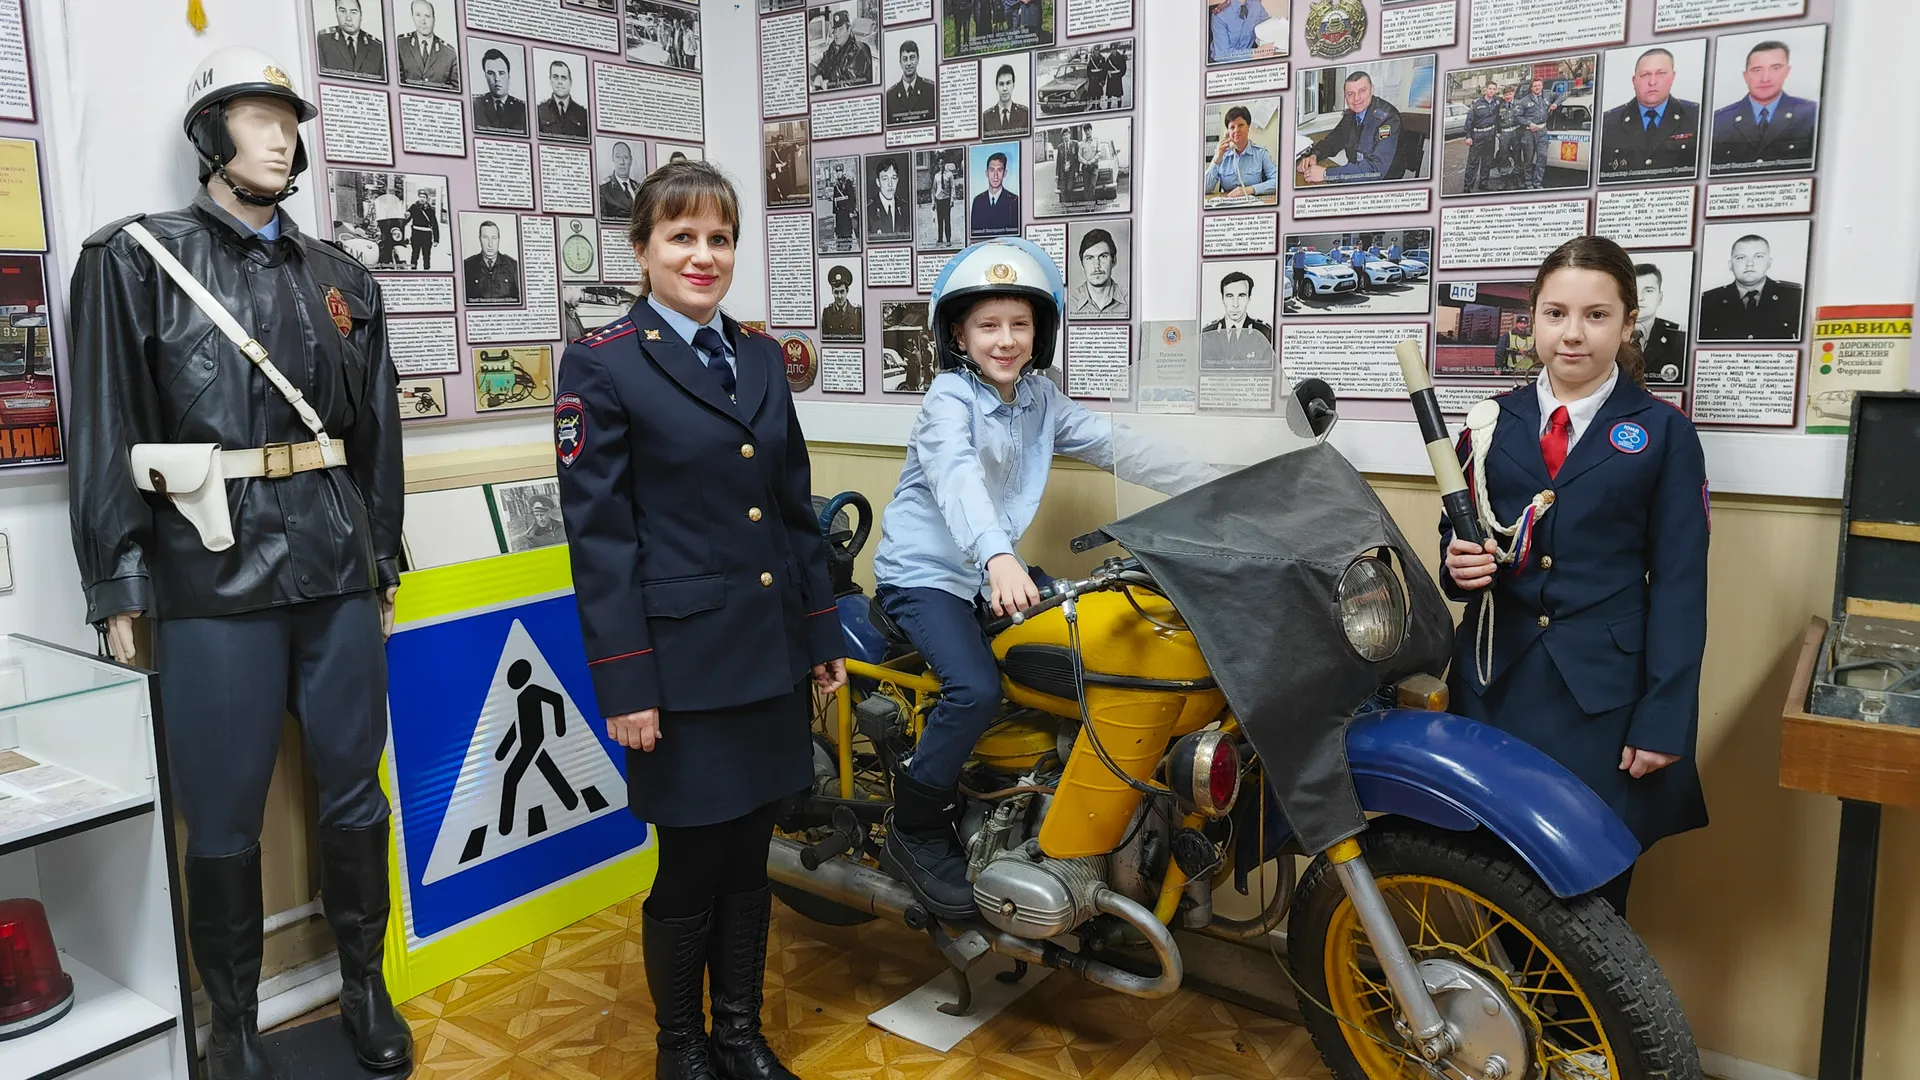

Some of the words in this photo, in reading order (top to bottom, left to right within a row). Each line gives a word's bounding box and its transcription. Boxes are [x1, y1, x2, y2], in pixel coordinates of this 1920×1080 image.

[187, 68, 213, 102] ГАИ
[1452, 286, 1474, 298] ДПС
[1816, 322, 1912, 335] ПРАВИЛА
[787, 364, 804, 374] ДПС
[1837, 368, 1881, 376] Федерации
